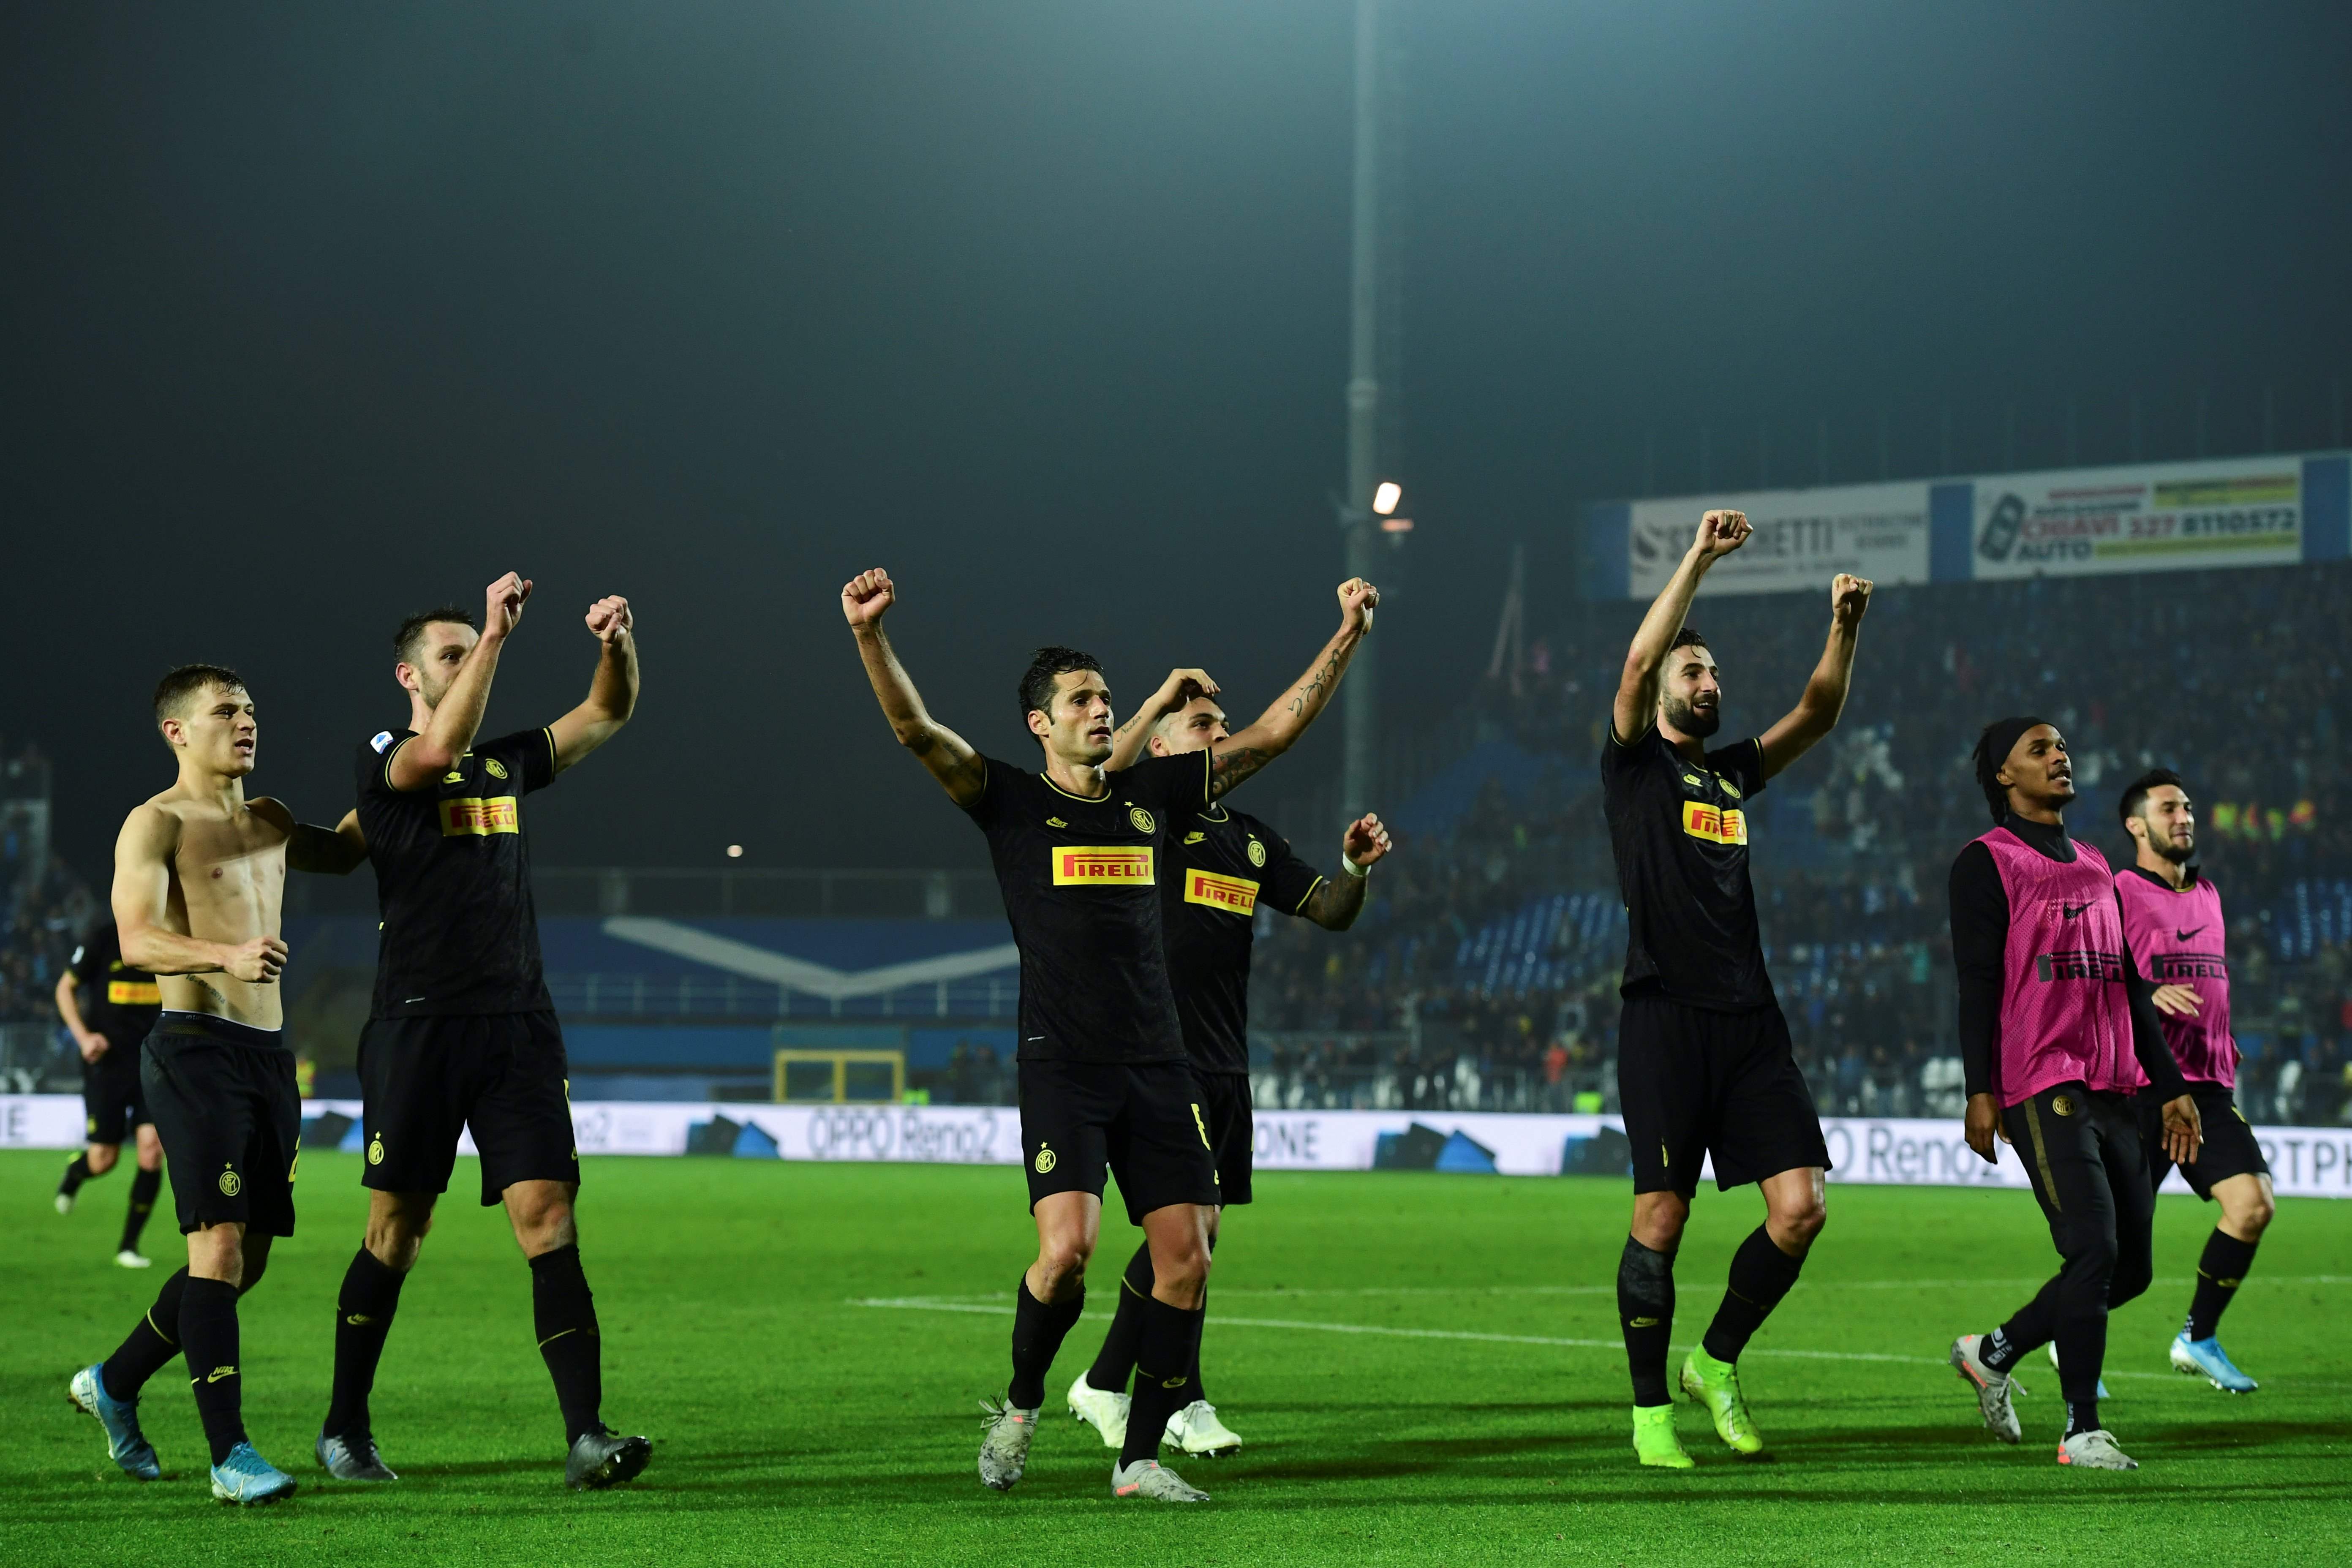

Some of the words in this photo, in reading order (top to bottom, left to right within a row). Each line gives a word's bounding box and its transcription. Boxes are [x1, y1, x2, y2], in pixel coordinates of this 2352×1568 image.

[2015, 539, 2092, 562] AUTO
[449, 804, 515, 828] PIRELLI
[1051, 817, 1068, 828] NIKE
[1063, 854, 1149, 877] PIRELLI
[1194, 877, 1256, 909] PIRELL
[807, 1109, 896, 1160] OPPO
[900, 1109, 1000, 1162] Reno2
